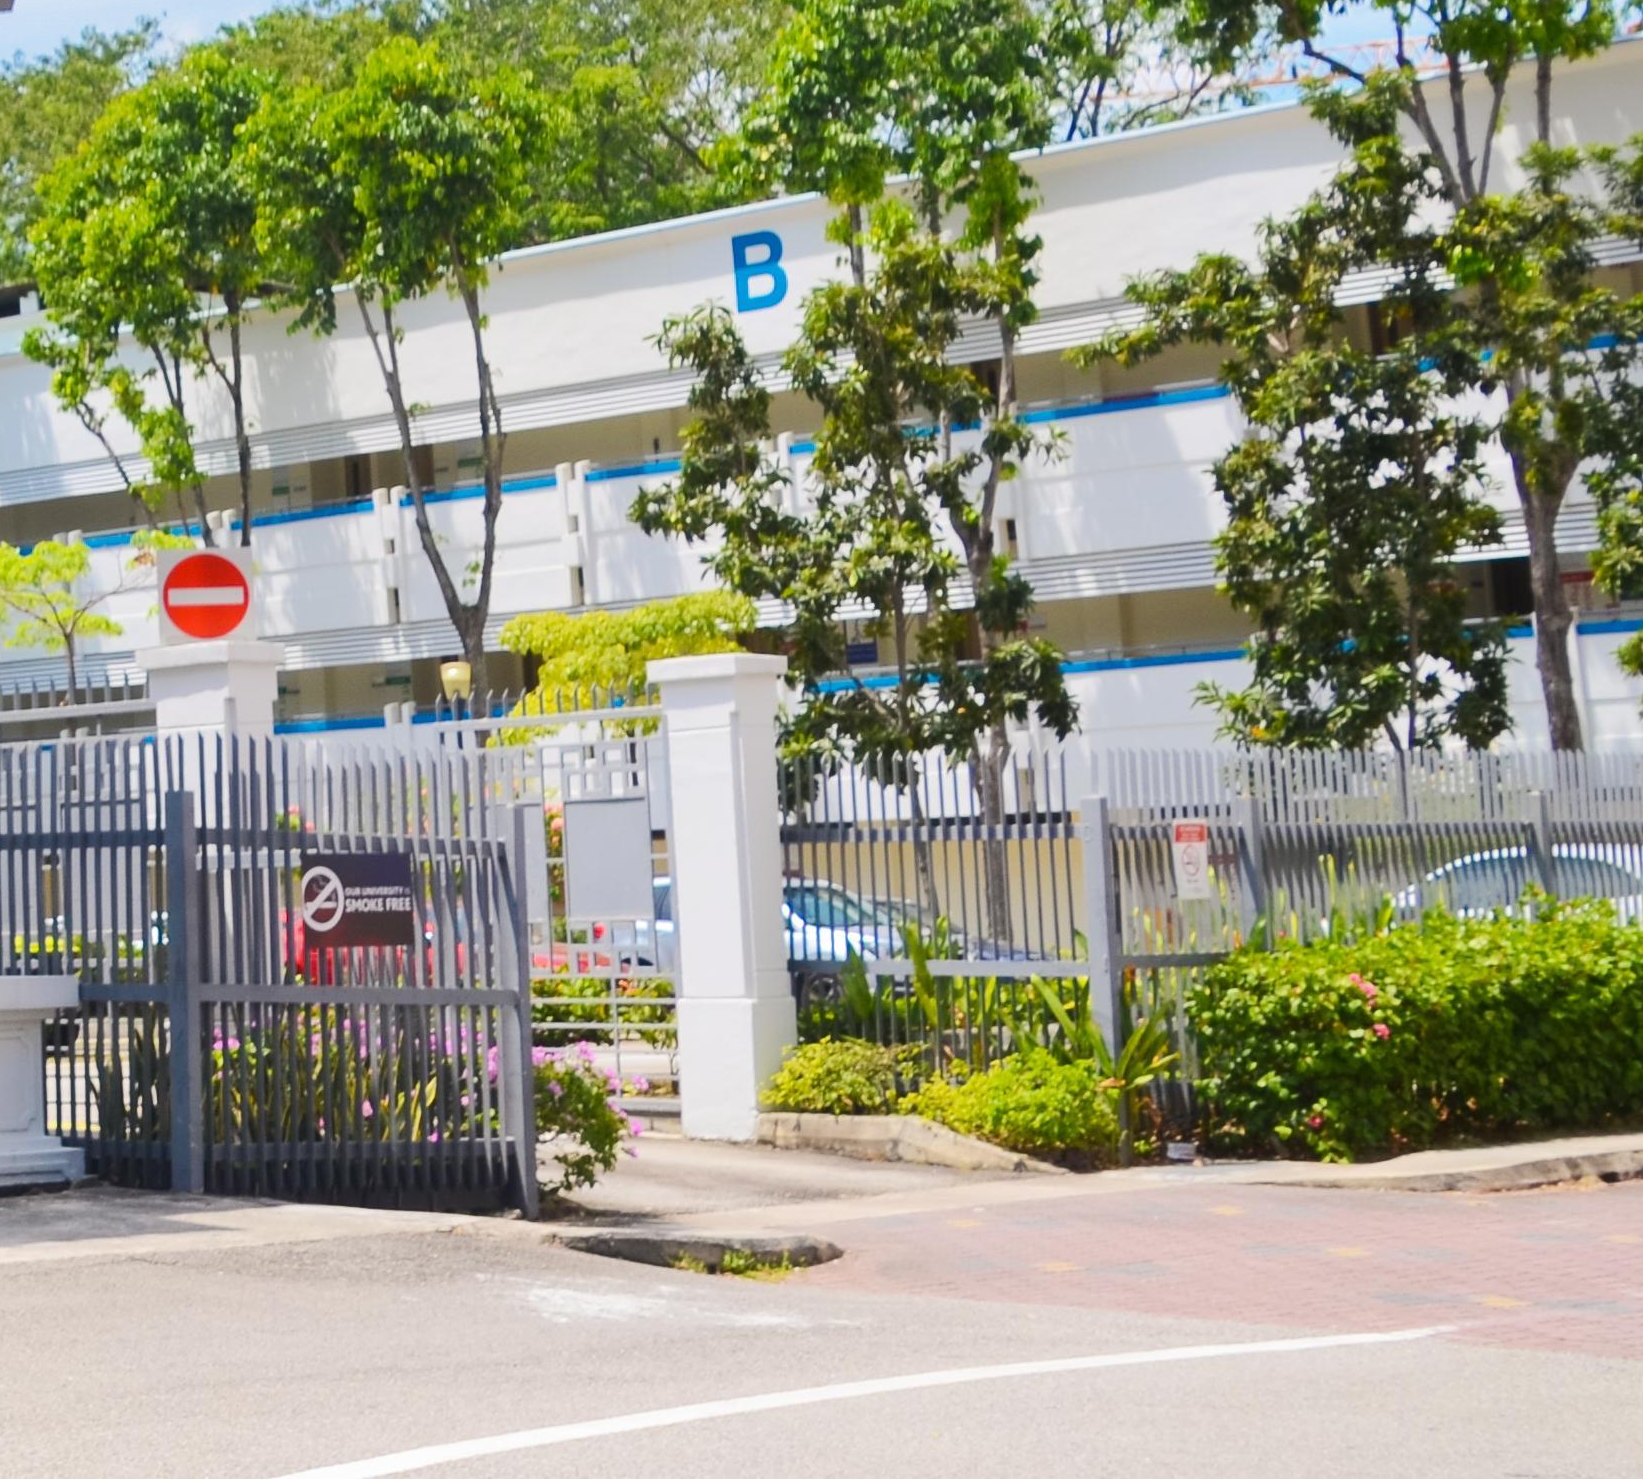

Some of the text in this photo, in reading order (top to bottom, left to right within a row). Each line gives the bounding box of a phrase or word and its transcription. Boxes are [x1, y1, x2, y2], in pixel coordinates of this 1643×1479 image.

[731, 230, 789, 313] B
[362, 885, 403, 896] UNIVERSITY
[345, 896, 411, 914] SMOKE FREE
